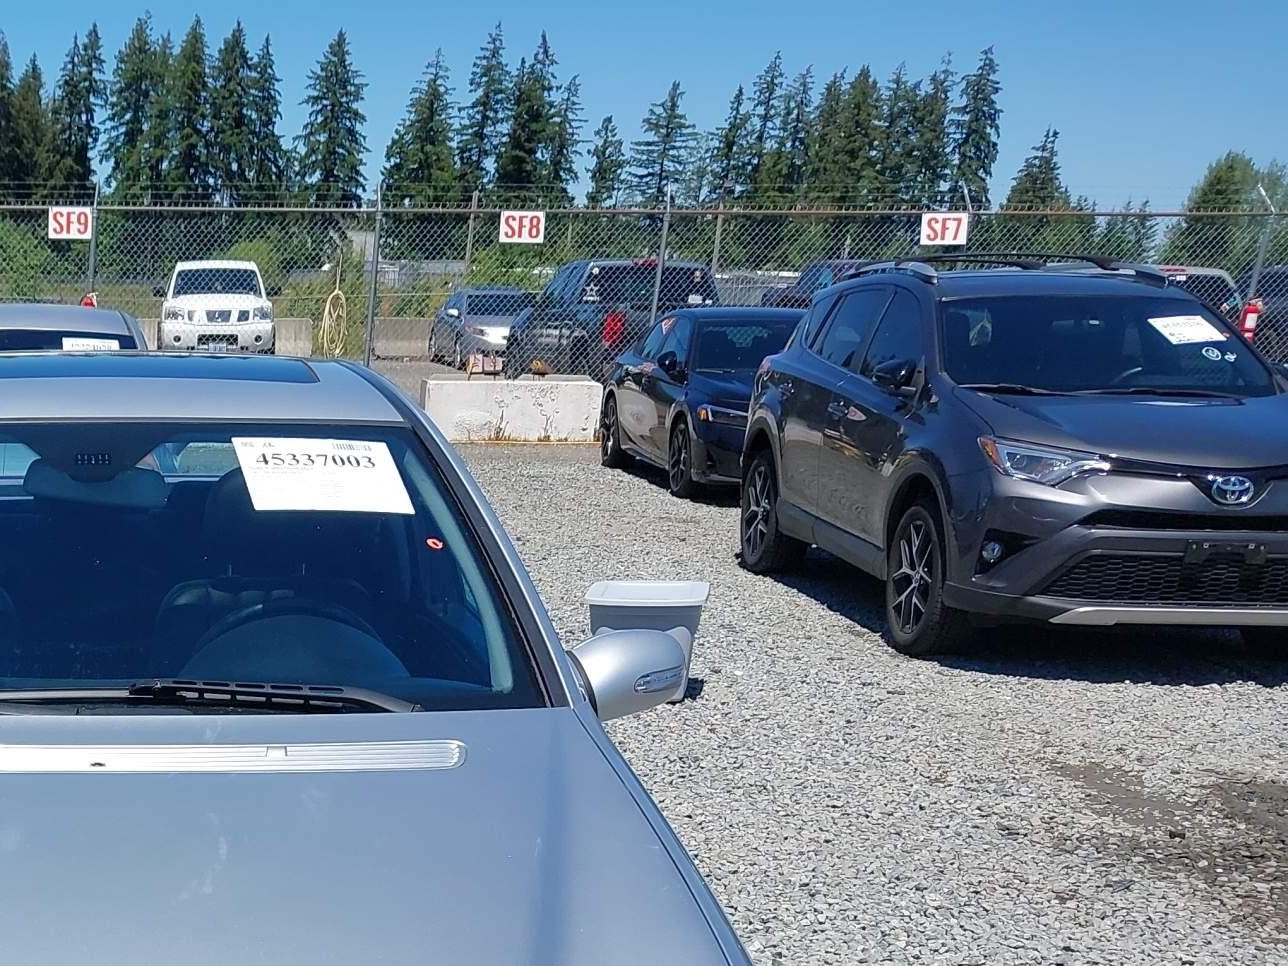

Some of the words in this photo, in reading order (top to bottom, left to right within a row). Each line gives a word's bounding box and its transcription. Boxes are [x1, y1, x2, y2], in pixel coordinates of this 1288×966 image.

[52, 211, 89, 235] SF9
[504, 215, 541, 239] SF8
[926, 217, 963, 242] SF7
[255, 452, 377, 469] 45337003
